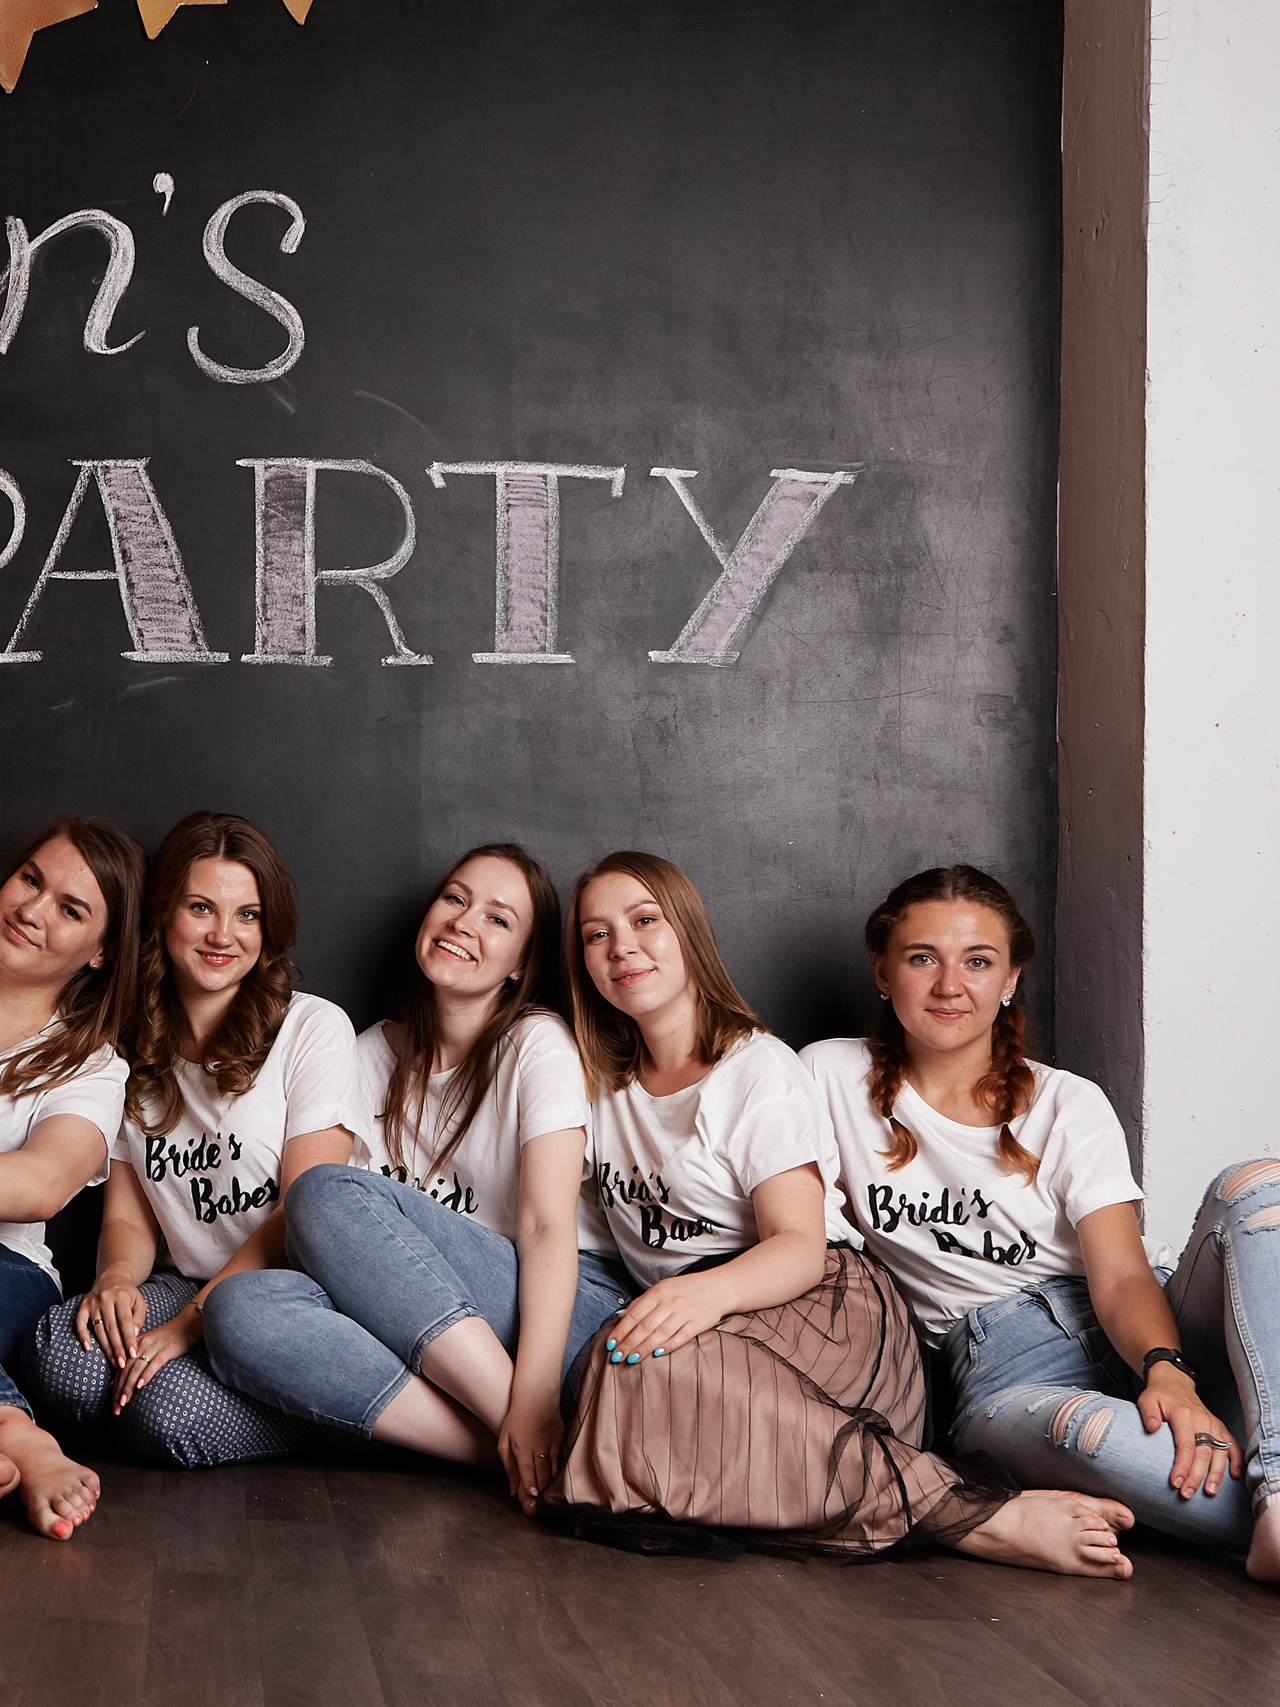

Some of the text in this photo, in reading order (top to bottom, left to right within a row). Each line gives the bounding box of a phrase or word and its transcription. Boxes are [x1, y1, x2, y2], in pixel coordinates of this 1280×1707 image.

[145, 1132, 243, 1182] Bride's
[867, 1183, 995, 1233] Bride's
[928, 1228, 1037, 1267] Bbes
